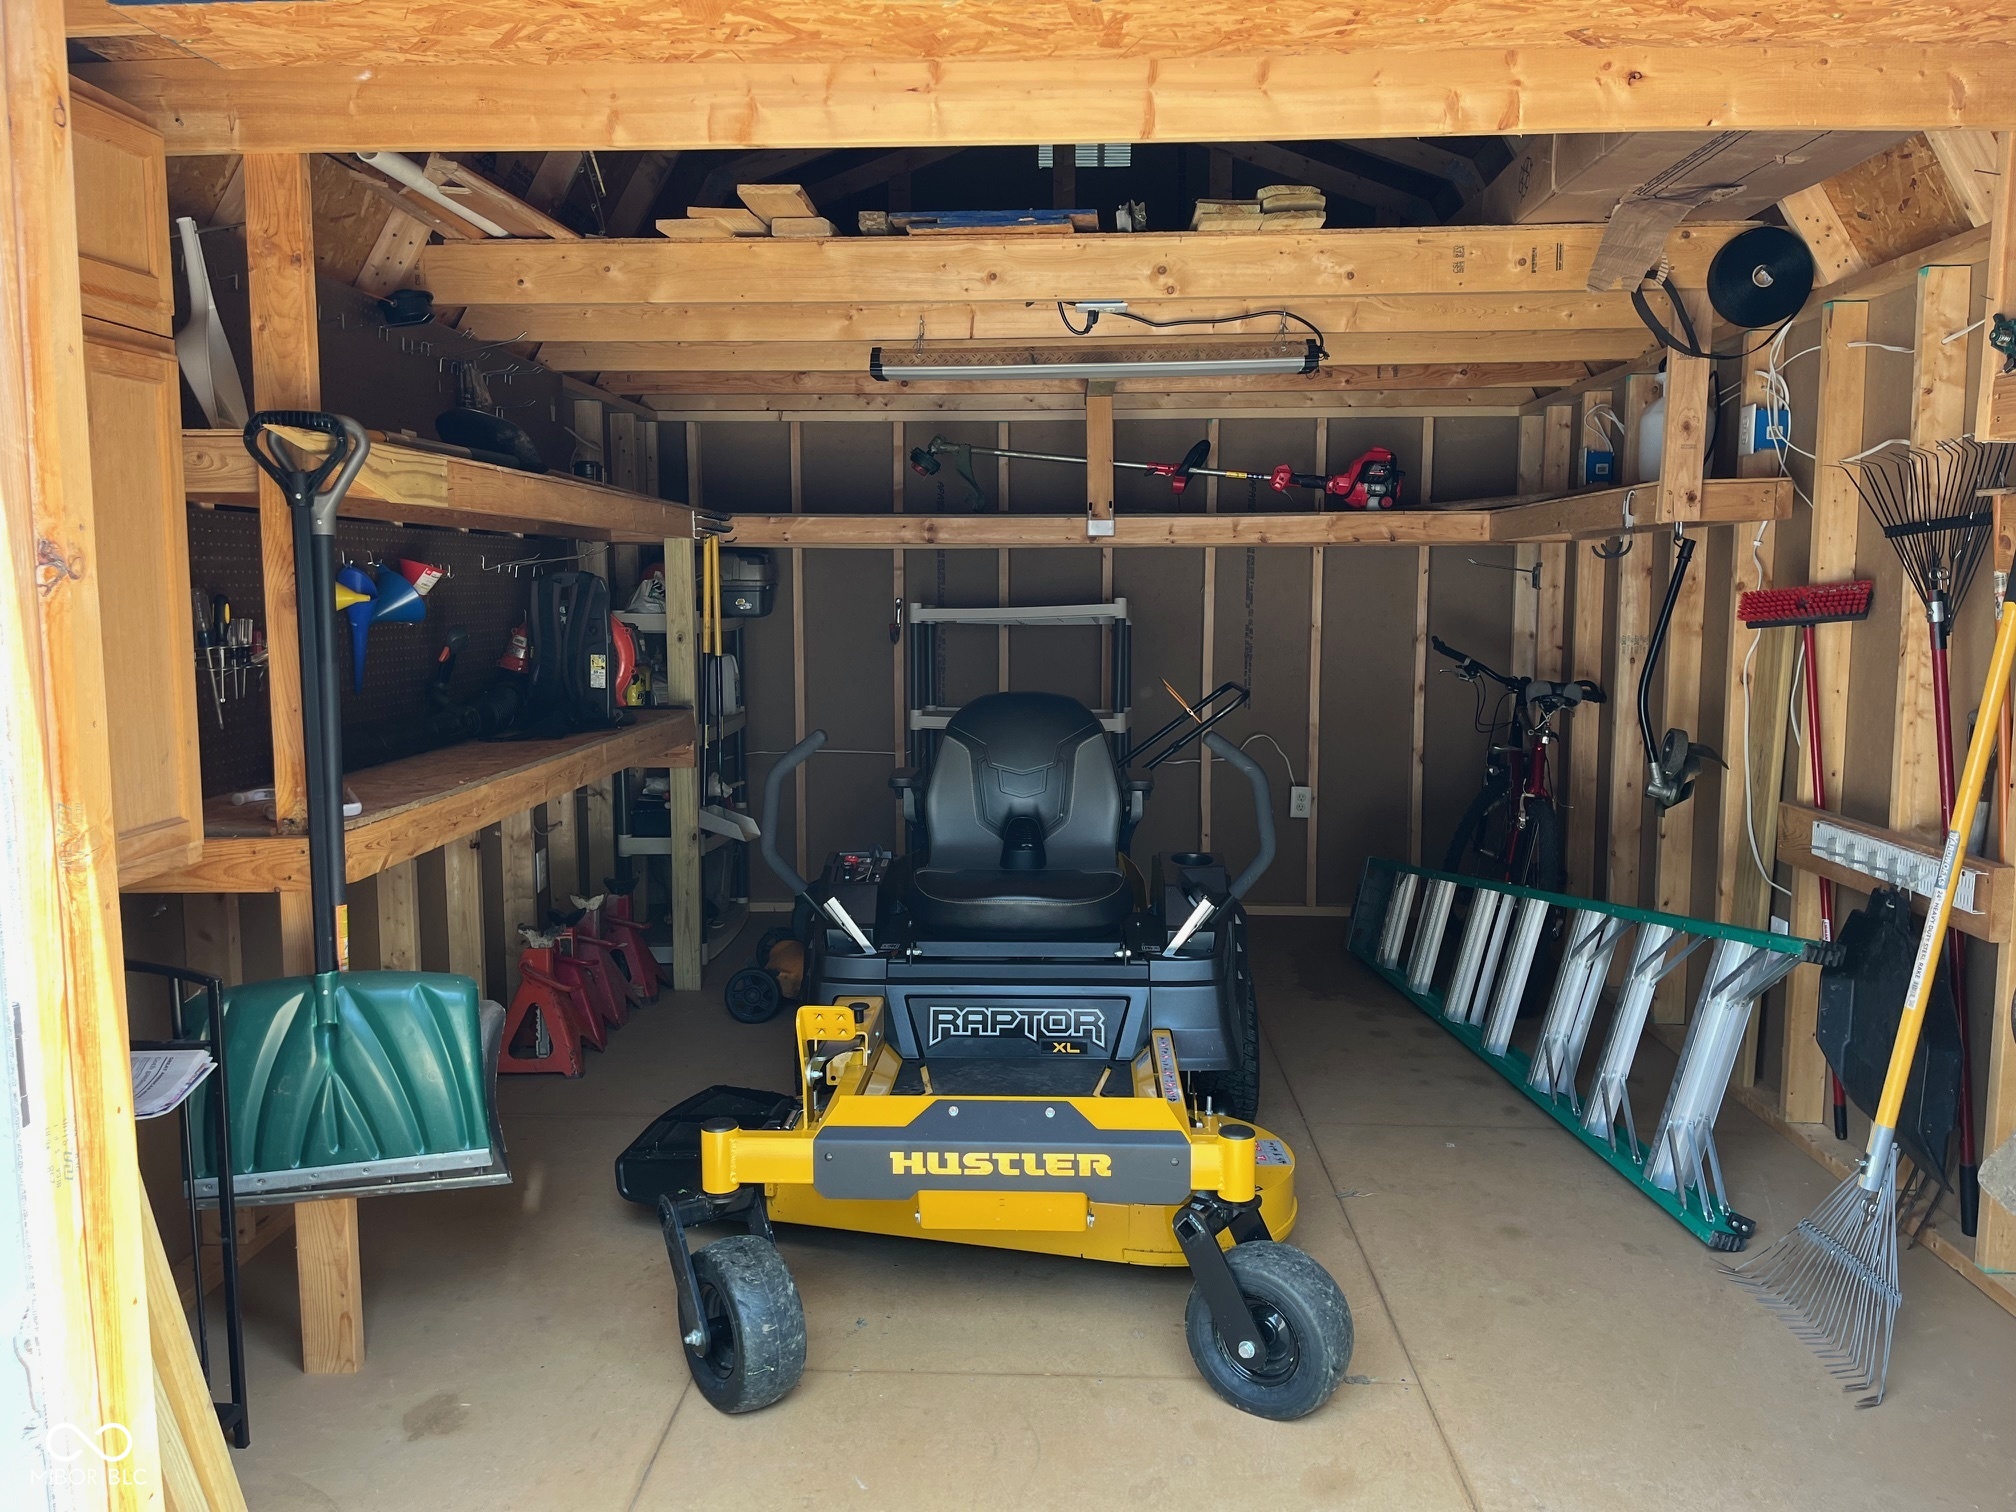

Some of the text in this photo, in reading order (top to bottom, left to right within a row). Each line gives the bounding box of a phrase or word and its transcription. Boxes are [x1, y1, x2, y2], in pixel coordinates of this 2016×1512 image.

[1937, 832, 1960, 887] YARDWORKS
[1930, 902, 1940, 924] HEAVY
[1915, 963, 1924, 979] RAKE
[929, 1006, 1105, 1048] RAPTOR
[1052, 1042, 1081, 1053] XL
[889, 1151, 1112, 1177] HUSTLER
